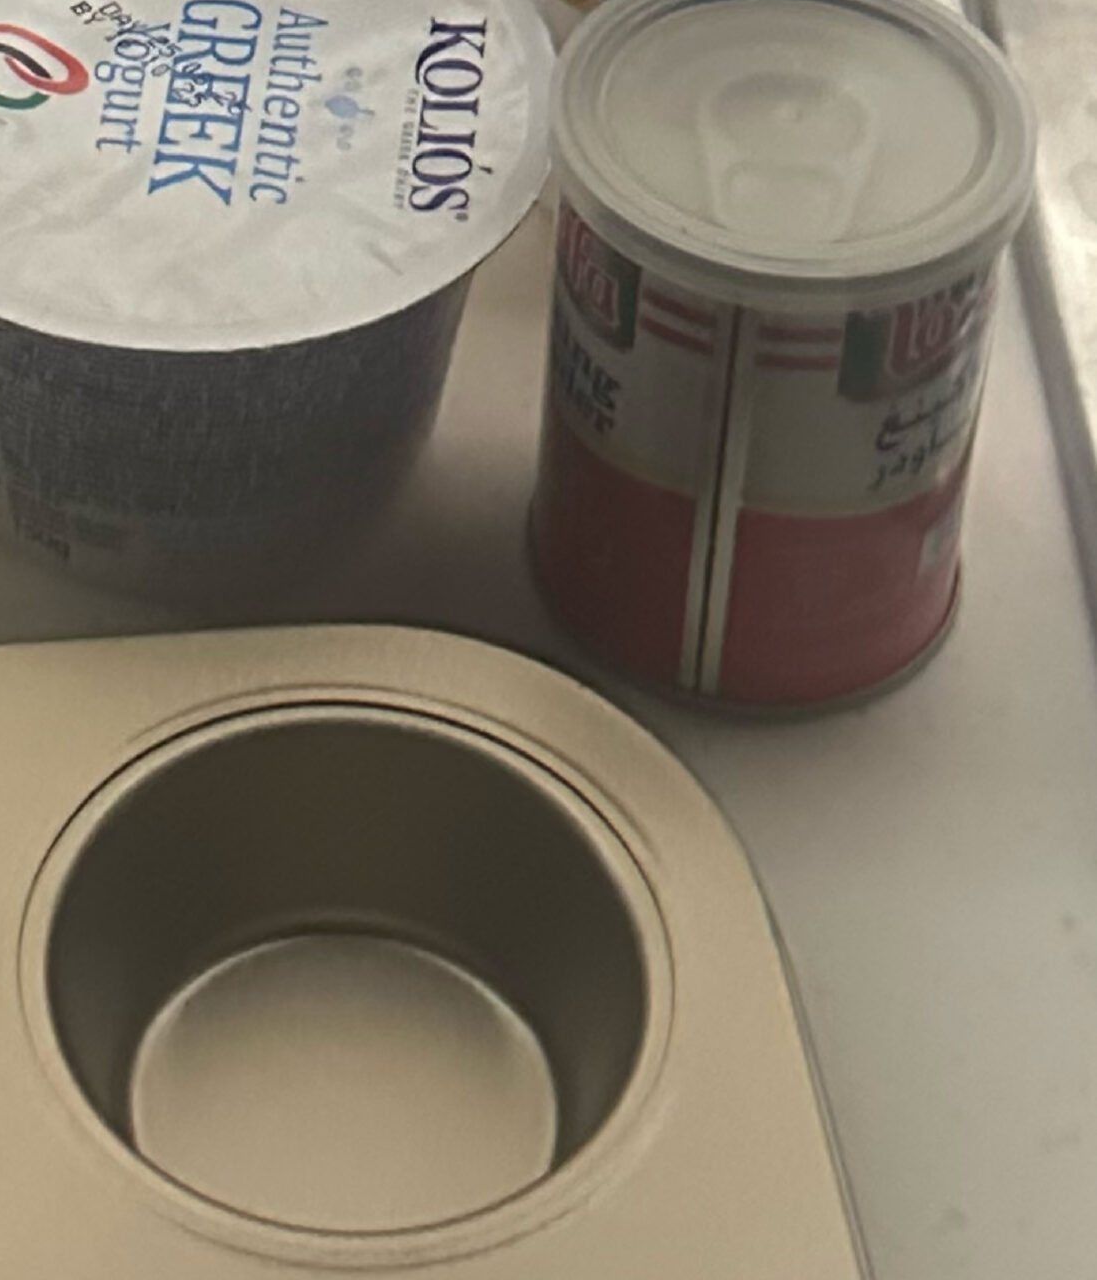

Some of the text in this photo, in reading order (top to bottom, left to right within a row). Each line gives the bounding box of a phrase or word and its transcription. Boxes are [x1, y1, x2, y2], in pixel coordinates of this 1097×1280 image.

[69, 0, 106, 26] BY
[95, 22, 171, 154] Yogurt
[249, 7, 330, 206] Authentic
[408, 16, 494, 215] KOLIÓS
